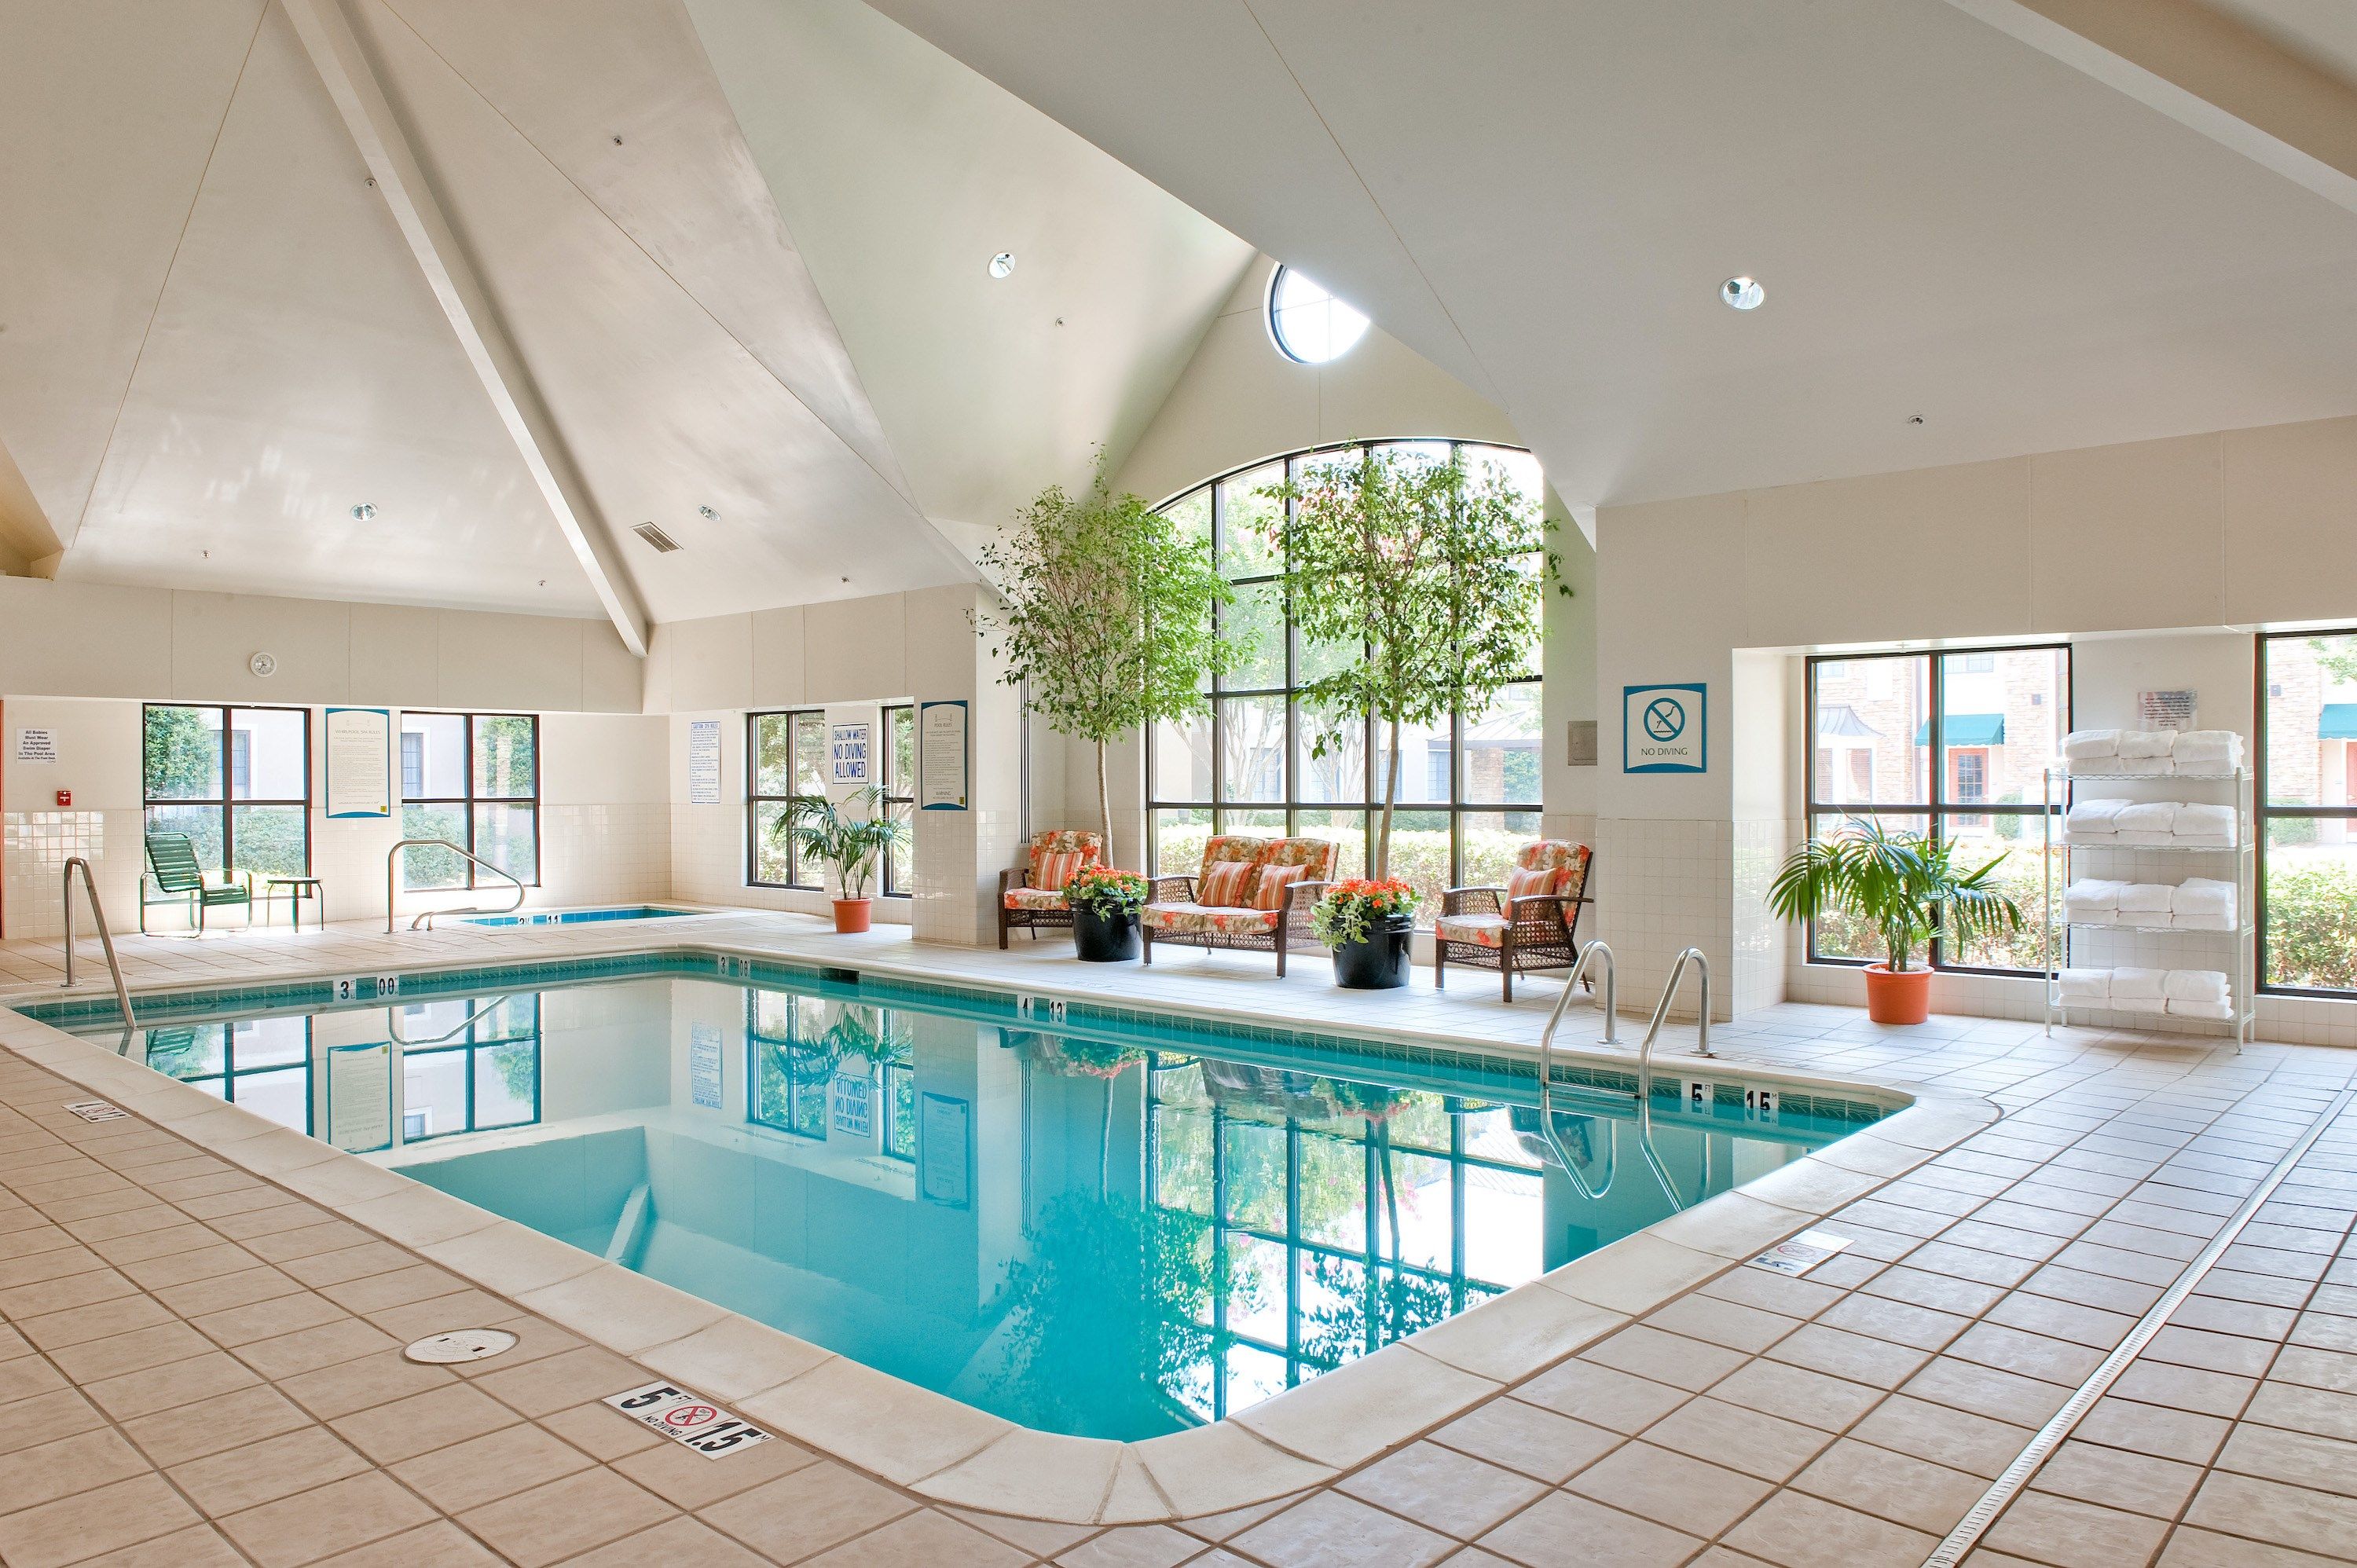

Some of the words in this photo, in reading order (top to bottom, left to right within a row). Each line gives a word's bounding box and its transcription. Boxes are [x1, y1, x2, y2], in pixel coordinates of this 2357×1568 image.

[834, 729, 852, 740] SHALLOW
[852, 728, 867, 739] WATER
[834, 744, 843, 760] NO
[845, 742, 866, 759] DIVING
[835, 762, 866, 778] ALLOWED
[1692, 1083, 1703, 1101] 5
[620, 1387, 681, 1409] 5
[643, 1415, 656, 1424] NO
[654, 1420, 683, 1437] DIVING
[684, 1421, 762, 1452] 1.5
